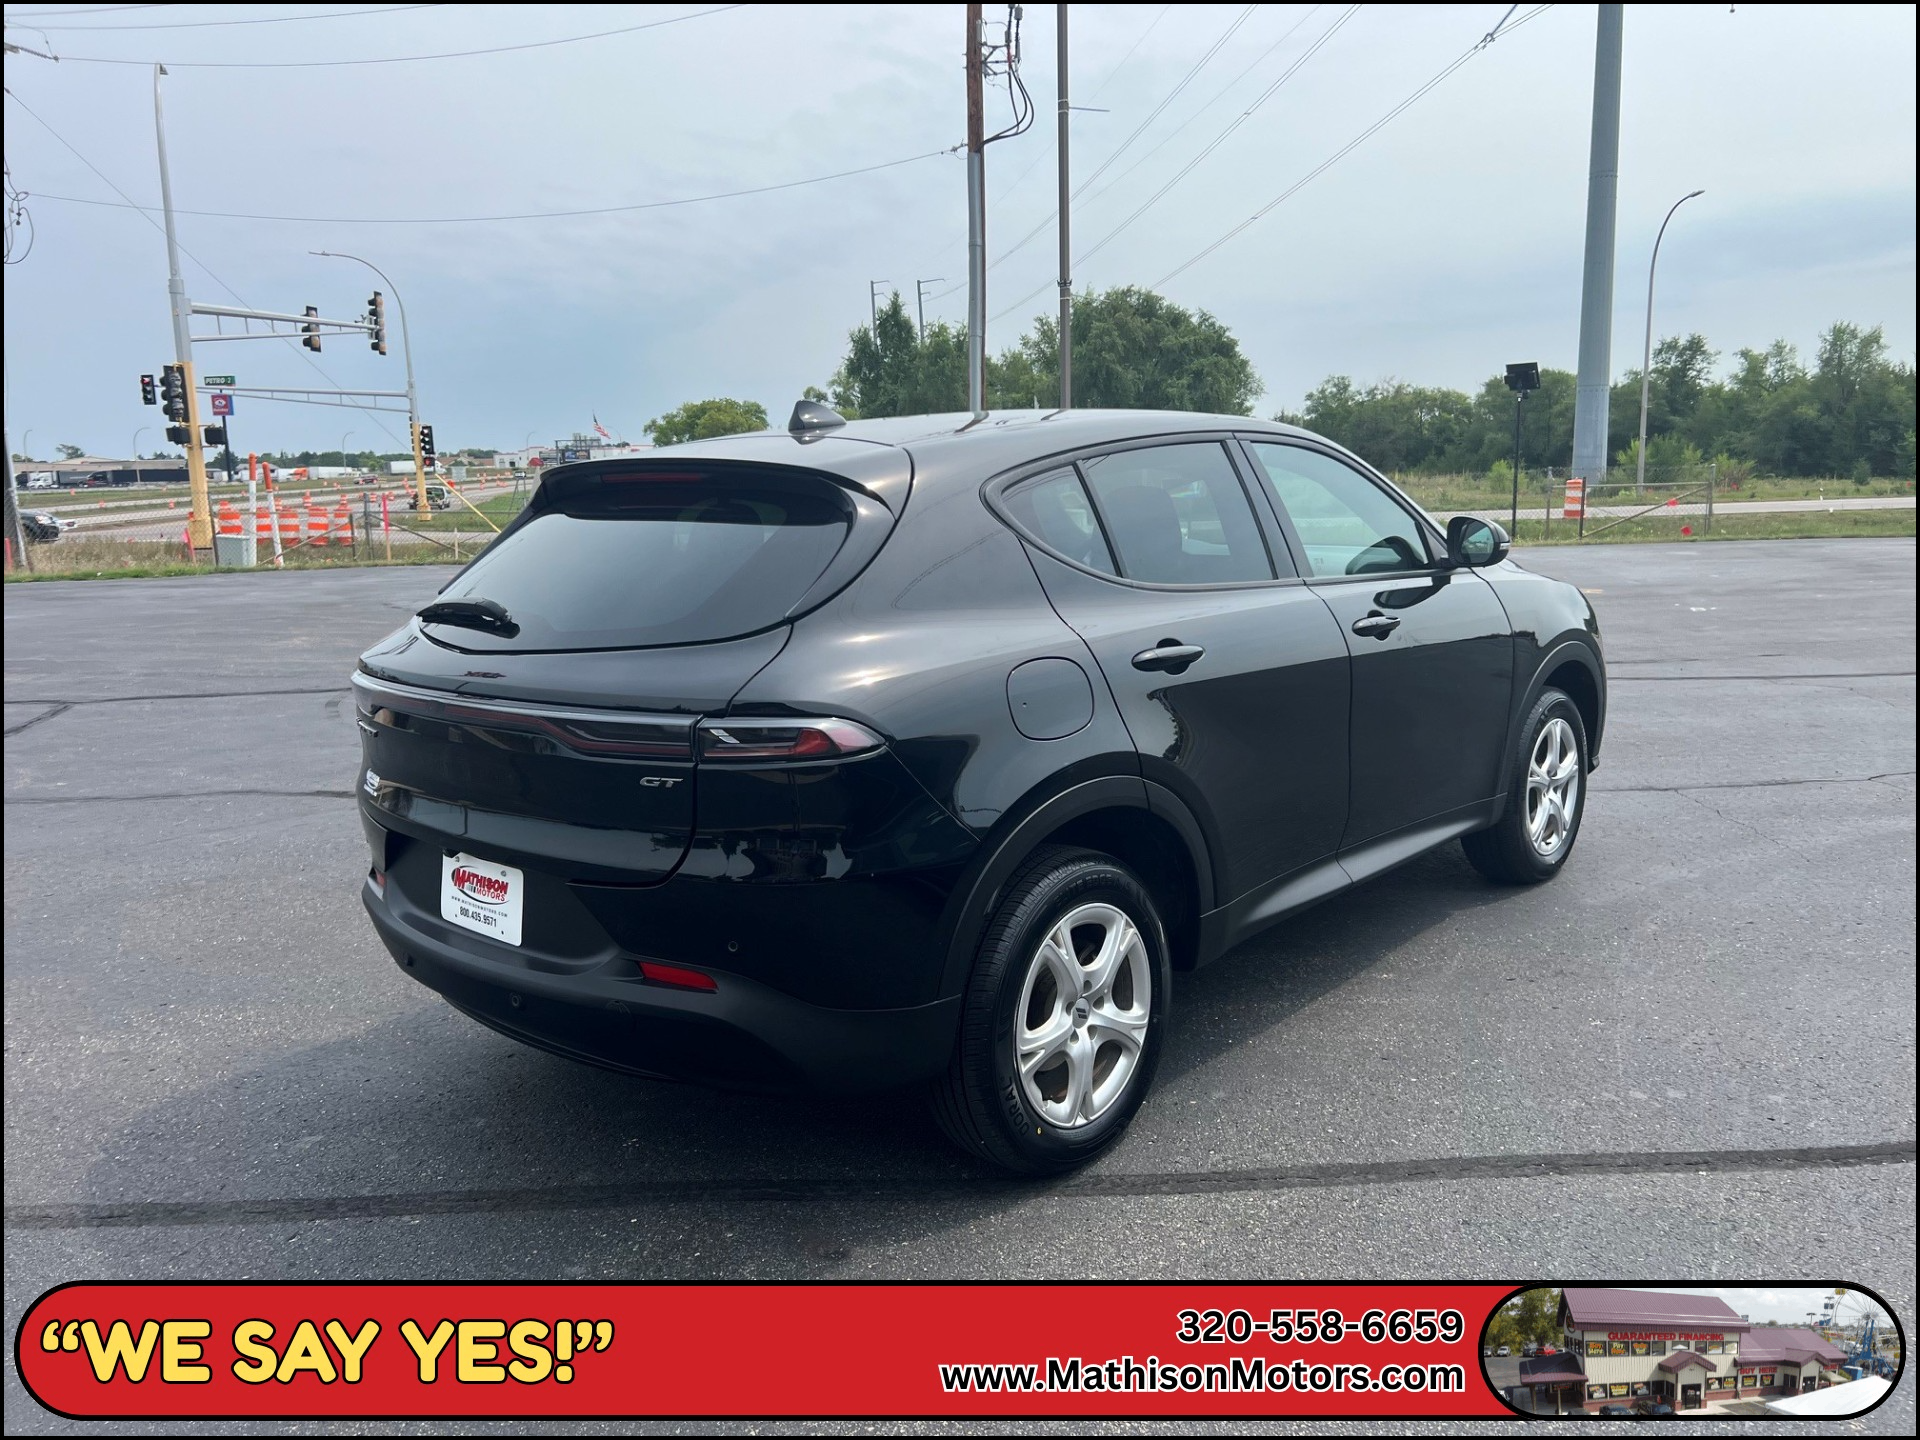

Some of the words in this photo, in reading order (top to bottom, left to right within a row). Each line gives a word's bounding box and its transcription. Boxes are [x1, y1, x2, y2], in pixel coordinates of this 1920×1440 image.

[639, 776, 684, 789] GT
[454, 868, 509, 895] MATHISON
[476, 887, 506, 902] MOTORS
[459, 906, 497, 928] 800.435.9571
